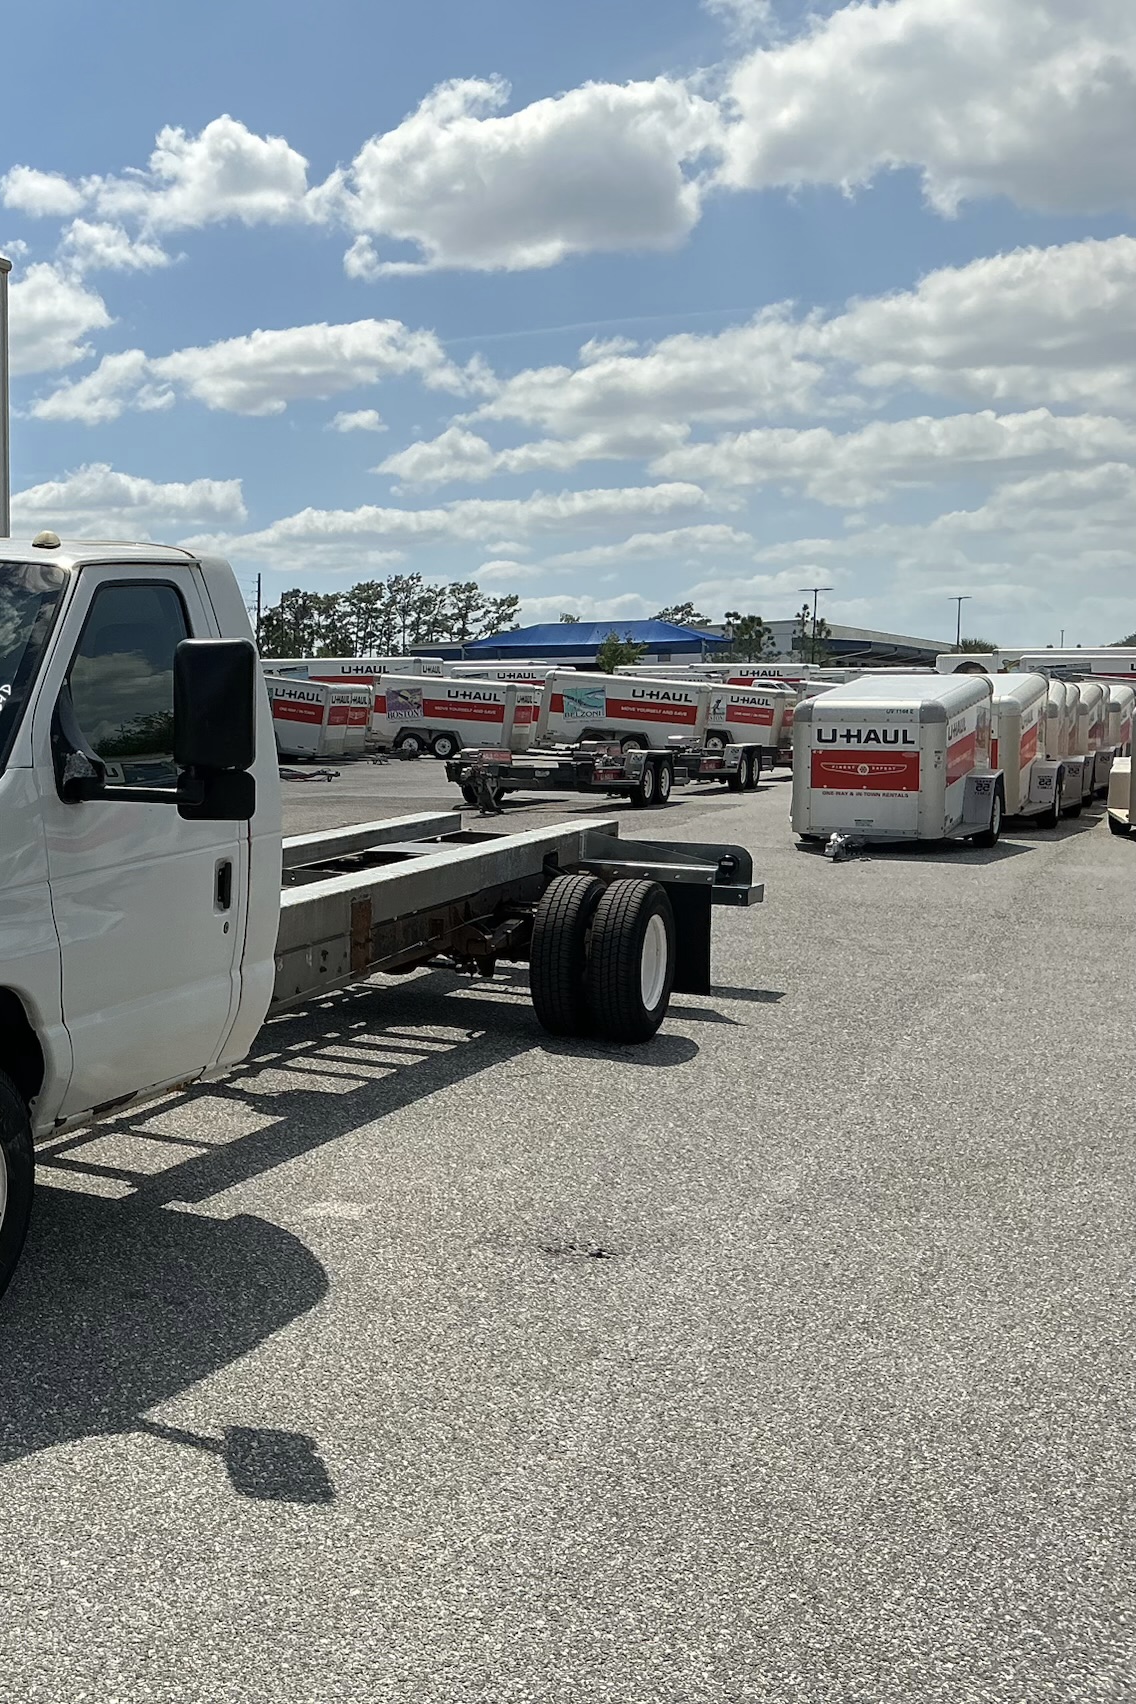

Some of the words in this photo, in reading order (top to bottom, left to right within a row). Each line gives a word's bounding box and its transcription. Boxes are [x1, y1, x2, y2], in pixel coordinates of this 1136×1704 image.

[341, 665, 390, 674] U-HAUL
[739, 669, 784, 677] U-HAUL
[274, 688, 322, 703] U-HAUL
[447, 689, 501, 702] U-HAUL
[631, 689, 693, 703] U-HAUL
[730, 695, 772, 706] U-HAUL
[387, 709, 419, 719] BOSTON
[816, 728, 915, 744] U-HAUL
